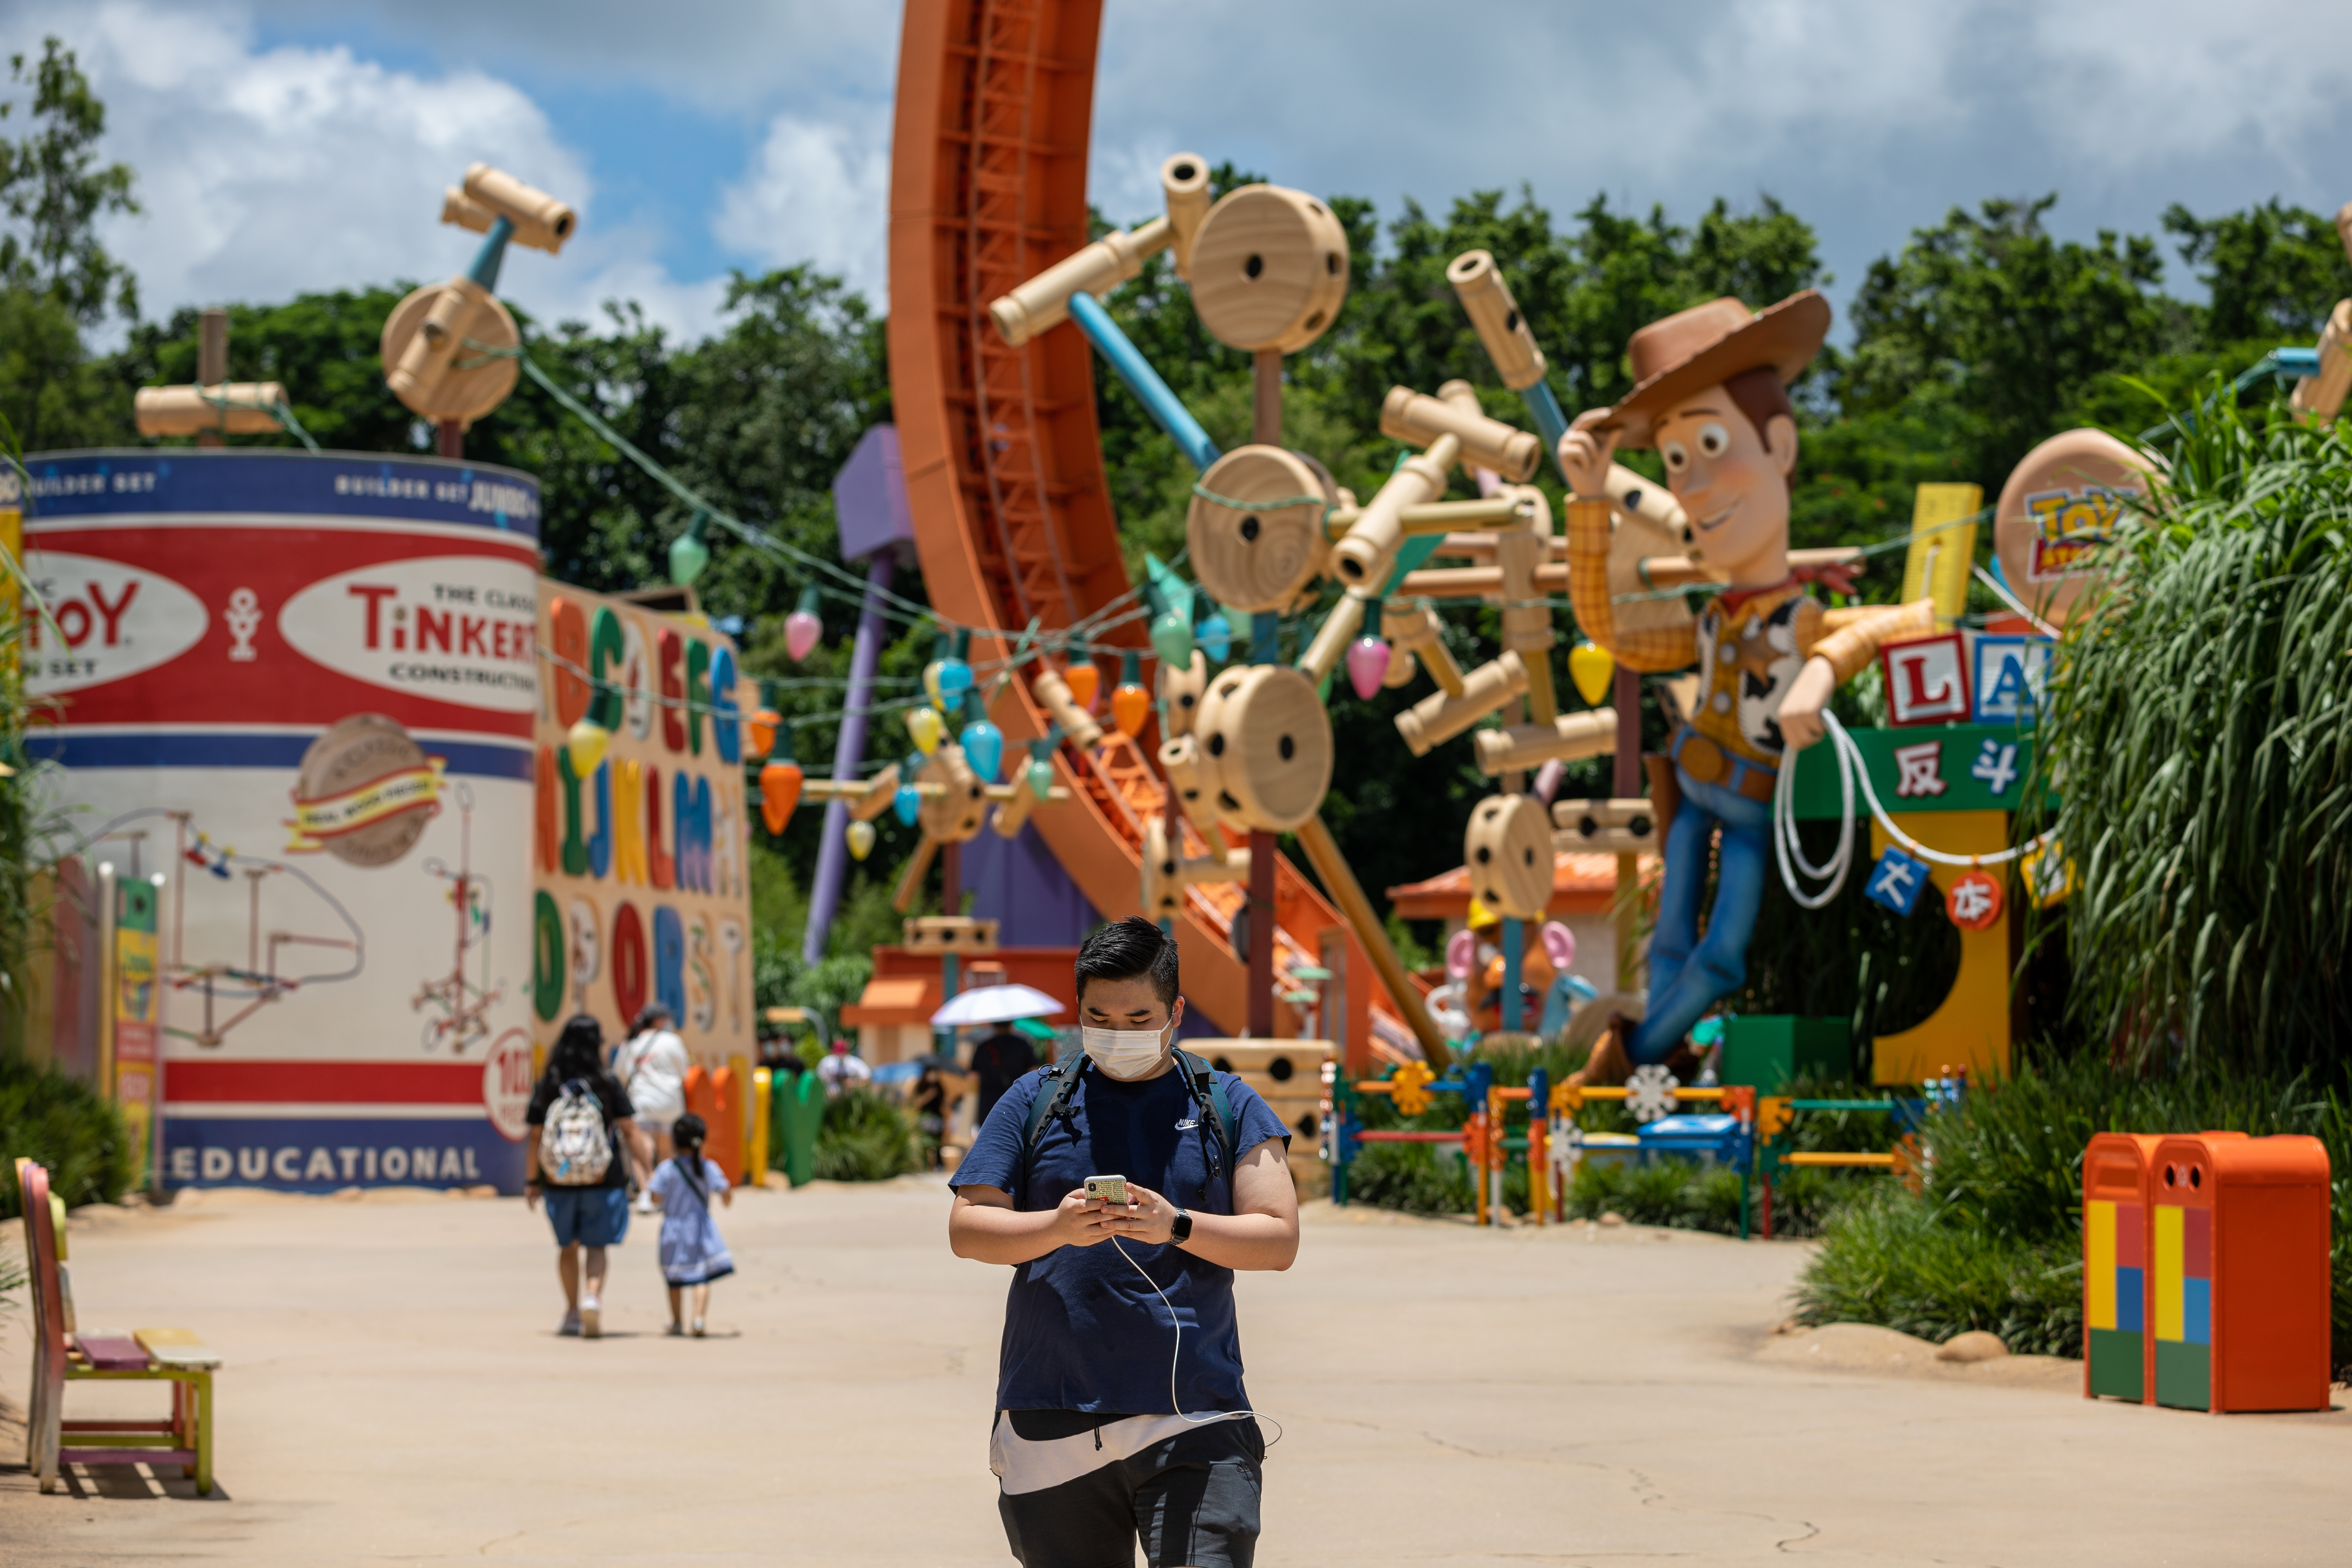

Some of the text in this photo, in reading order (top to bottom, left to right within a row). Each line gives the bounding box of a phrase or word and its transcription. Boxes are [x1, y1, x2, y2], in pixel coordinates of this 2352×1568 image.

[28, 475, 106, 496] UILDER
[114, 473, 156, 492] SET
[336, 475, 430, 499] BUILDER
[433, 584, 477, 604] THE
[49, 658, 98, 677] SET
[172, 1147, 480, 1181] EDUCATIONAL
